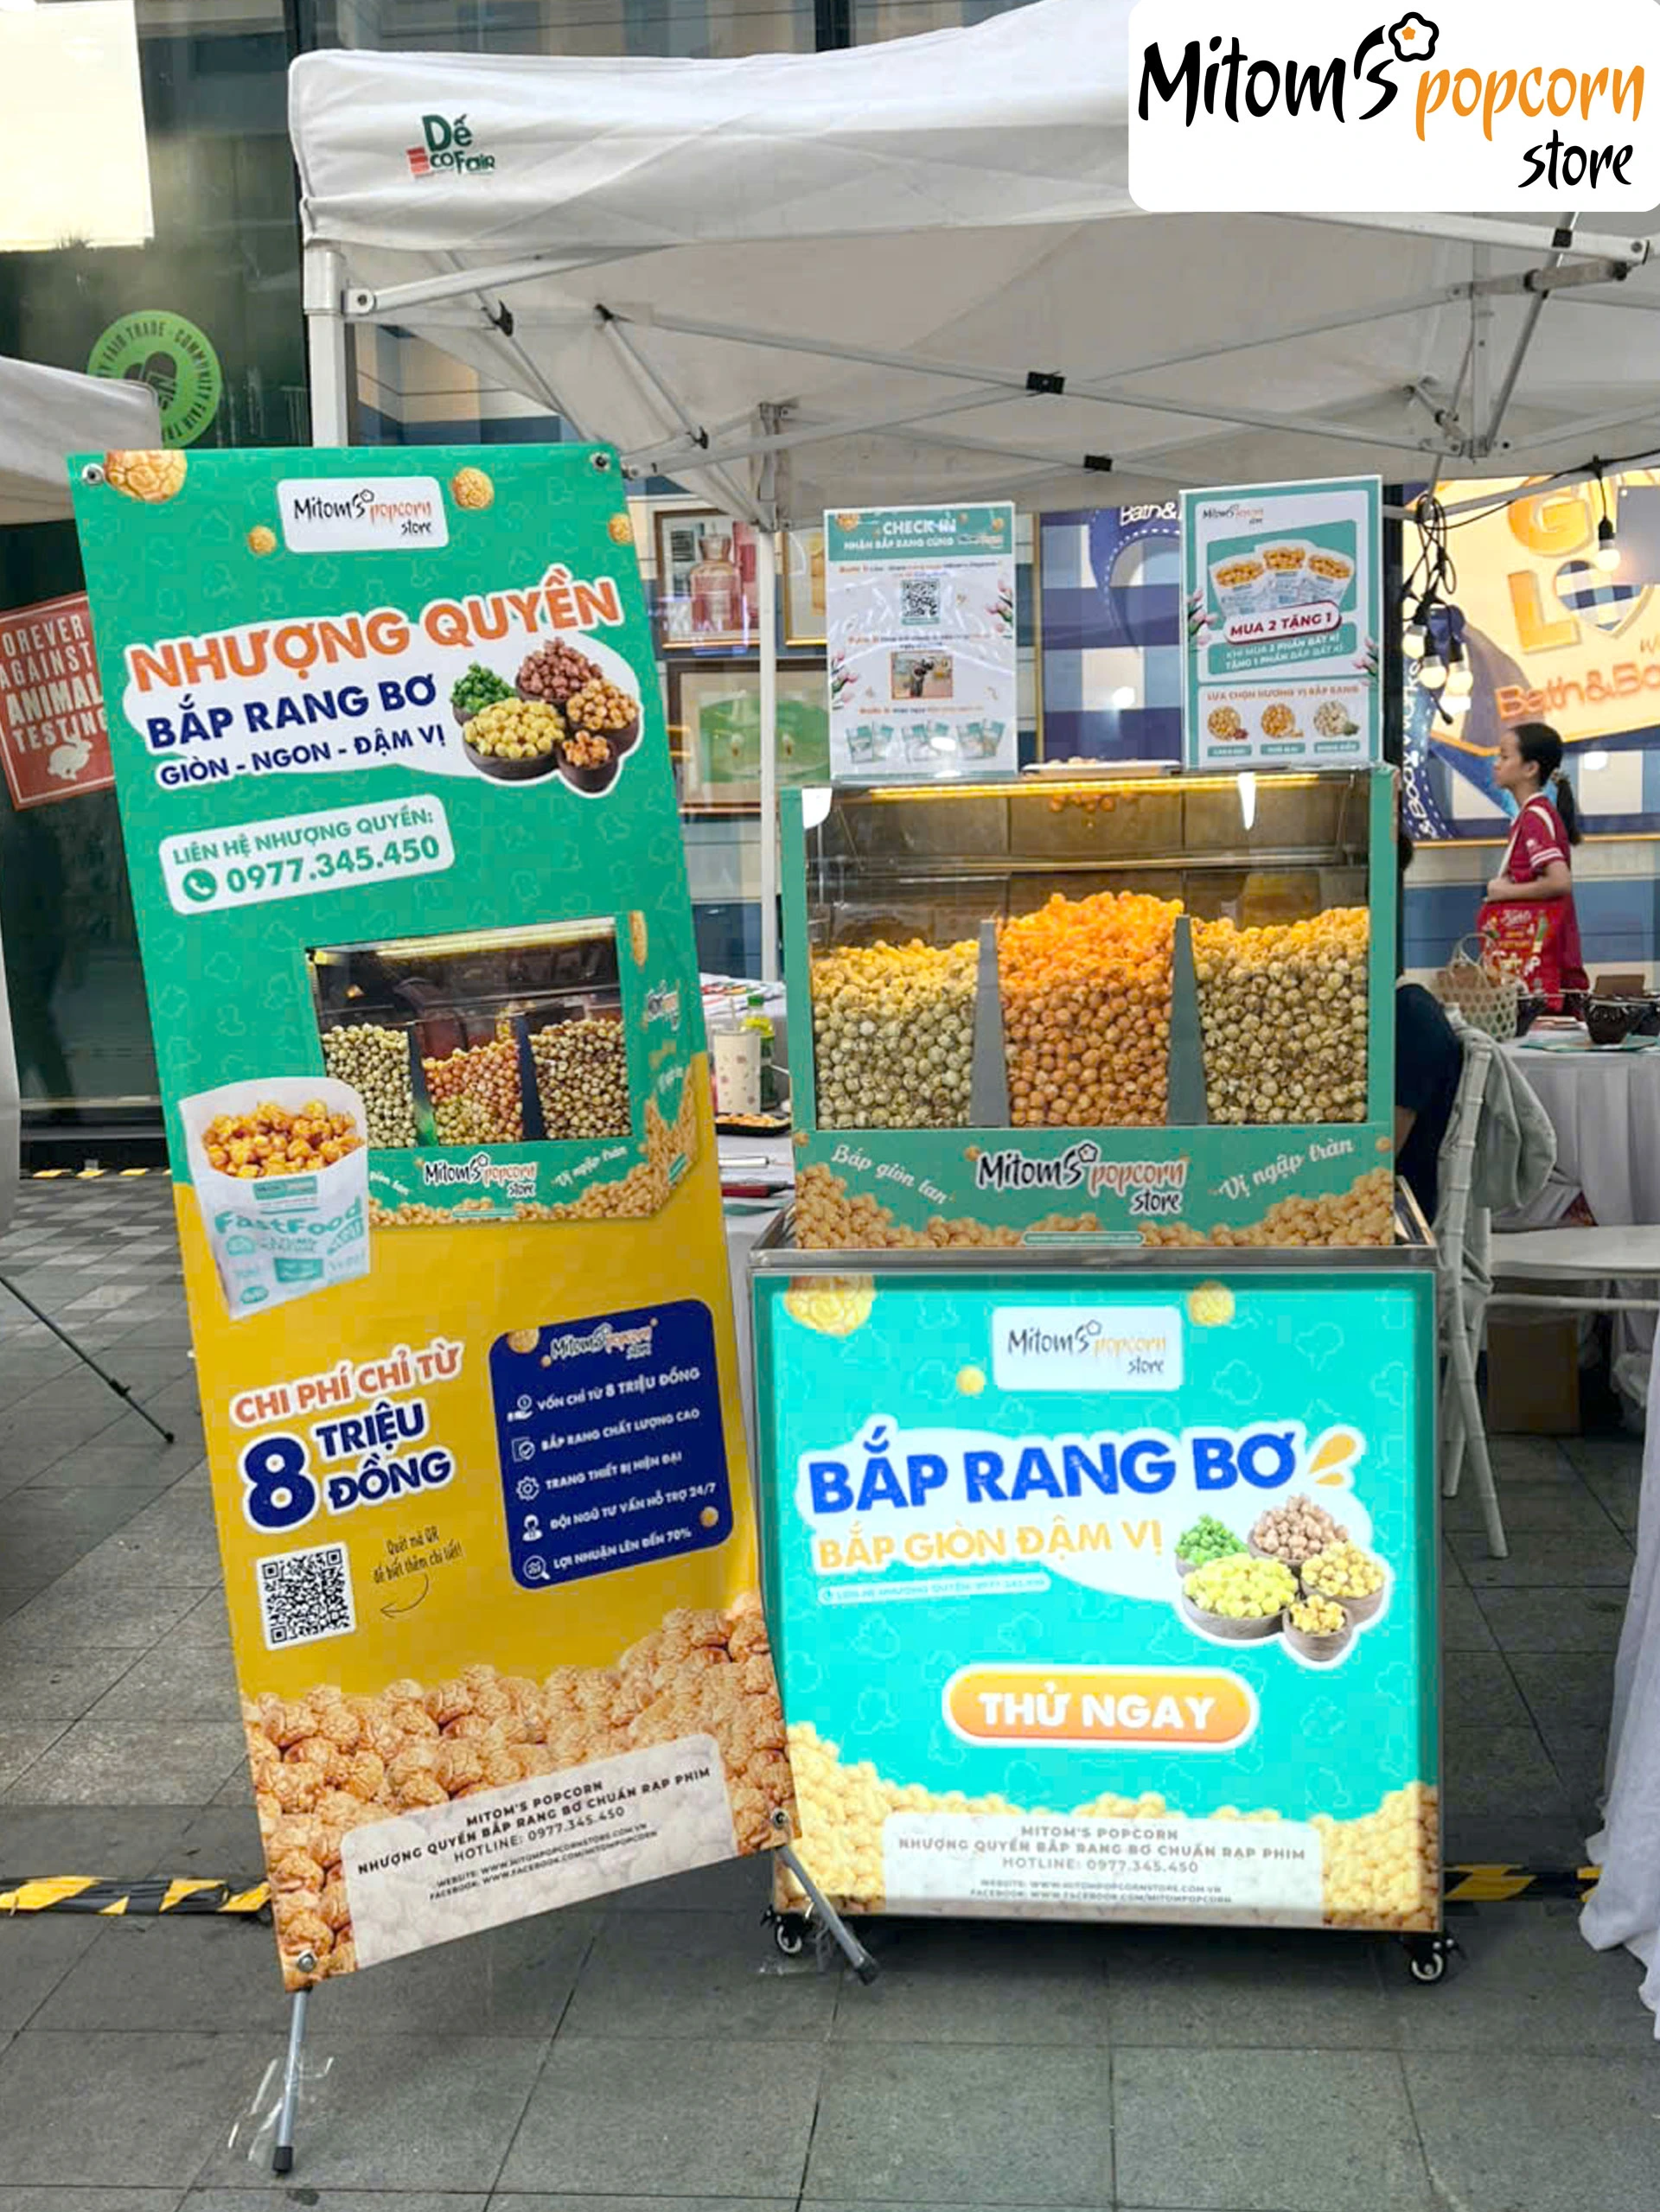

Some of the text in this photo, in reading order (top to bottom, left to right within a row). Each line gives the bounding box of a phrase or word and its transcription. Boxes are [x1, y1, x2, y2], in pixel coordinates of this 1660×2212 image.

[369, 500, 431, 525] popcorn
[400, 519, 432, 537] store
[129, 568, 620, 692] NHƯỢNG QUYỀN
[1230, 612, 1332, 637] MUA 2 TẶNG 1
[0, 641, 93, 690] AGAINST
[5, 672, 104, 727] ANIMAL
[146, 673, 437, 749] BẮP RANG BƠ
[160, 724, 446, 786] GIÒN NGON ĐẬM VỊ
[173, 839, 220, 866] LIÊN
[223, 833, 251, 858] HỆ
[255, 820, 353, 851] NHƯỢNG
[227, 834, 440, 893] 0977.345.450
[831, 1143, 872, 1171] Bắp
[1089, 1161, 1185, 1195] popcorn
[1133, 1190, 1181, 1212] store
[234, 1342, 461, 1424] CHI PHÍ CHỈ TỪ
[605, 1385, 616, 1398] 8
[567, 1429, 601, 1446] RANG
[676, 1408, 700, 1423] CAO
[244, 1400, 425, 1528] 8 TRIỆU
[328, 1451, 452, 1509] ĐỒNG
[546, 1475, 586, 1491] TRANG
[808, 1425, 1299, 1514] BẮP RANG BƠ
[689, 1482, 718, 1498] 24/7
[667, 1527, 693, 1543] 70%
[818, 1514, 1163, 1570] BẮP GIÒN ĐẬM VỊ
[978, 1680, 1217, 1730] THỬ NGAY
[358, 1846, 423, 1875] NHƯỢNG
[482, 1820, 512, 1838] BẮP
[516, 1808, 558, 1829] RANG
[561, 1801, 583, 1815] BƠ
[675, 1767, 711, 1786] PHIM
[467, 1781, 603, 1826] MITOM'S POPCORN
[454, 1806, 625, 1863] HOTLINE: 0977.345.450
[898, 1838, 969, 1852] NHƯỢNG
[1076, 1842, 1122, 1855] RANG
[1262, 1847, 1306, 1860] PHIM
[1021, 1825, 1178, 1840] MITOM'S POPCORN
[437, 1870, 477, 1888] WEBSITE:
[1002, 1857, 1199, 1874] HOTLINE: 0977.345.450
[429, 1879, 480, 1901] FACEBOOK:
